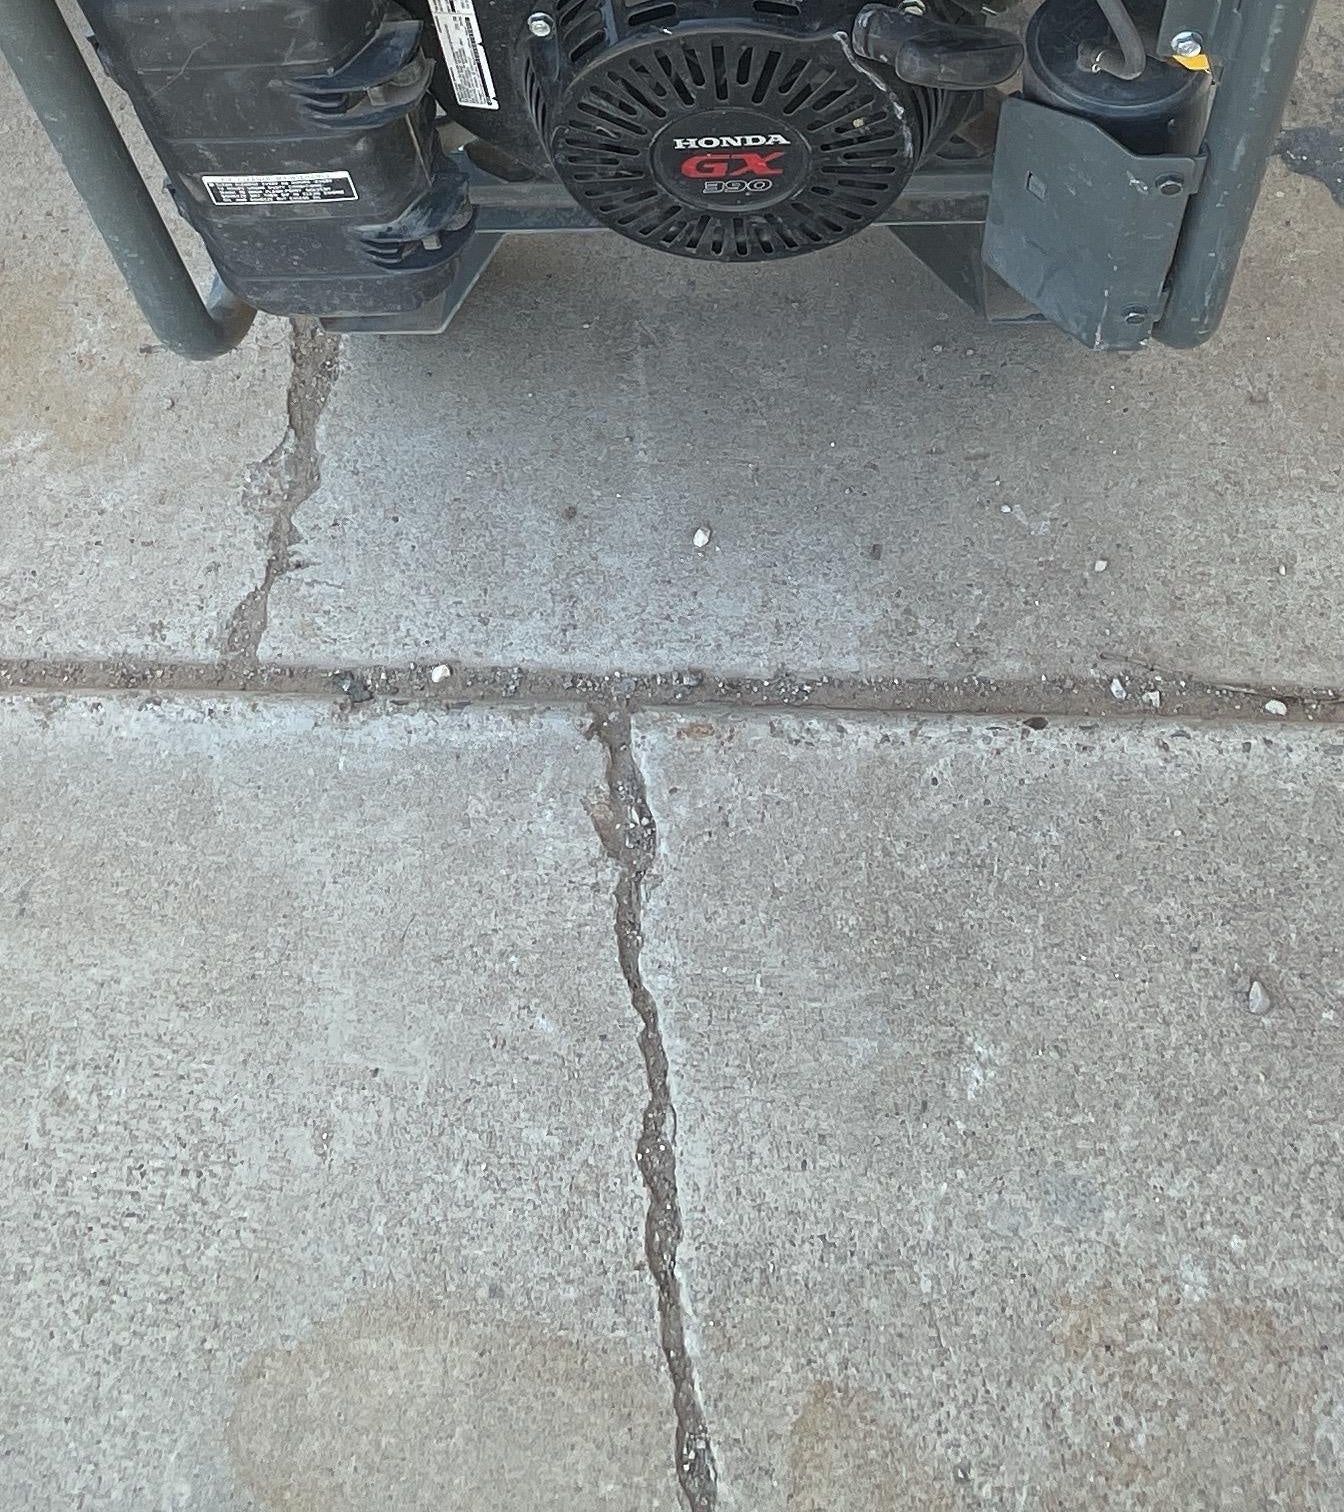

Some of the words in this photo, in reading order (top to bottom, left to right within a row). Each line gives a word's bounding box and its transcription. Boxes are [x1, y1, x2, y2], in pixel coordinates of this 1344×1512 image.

[673, 134, 791, 150] HONDA
[681, 150, 785, 179] GX
[703, 178, 773, 194] 390
